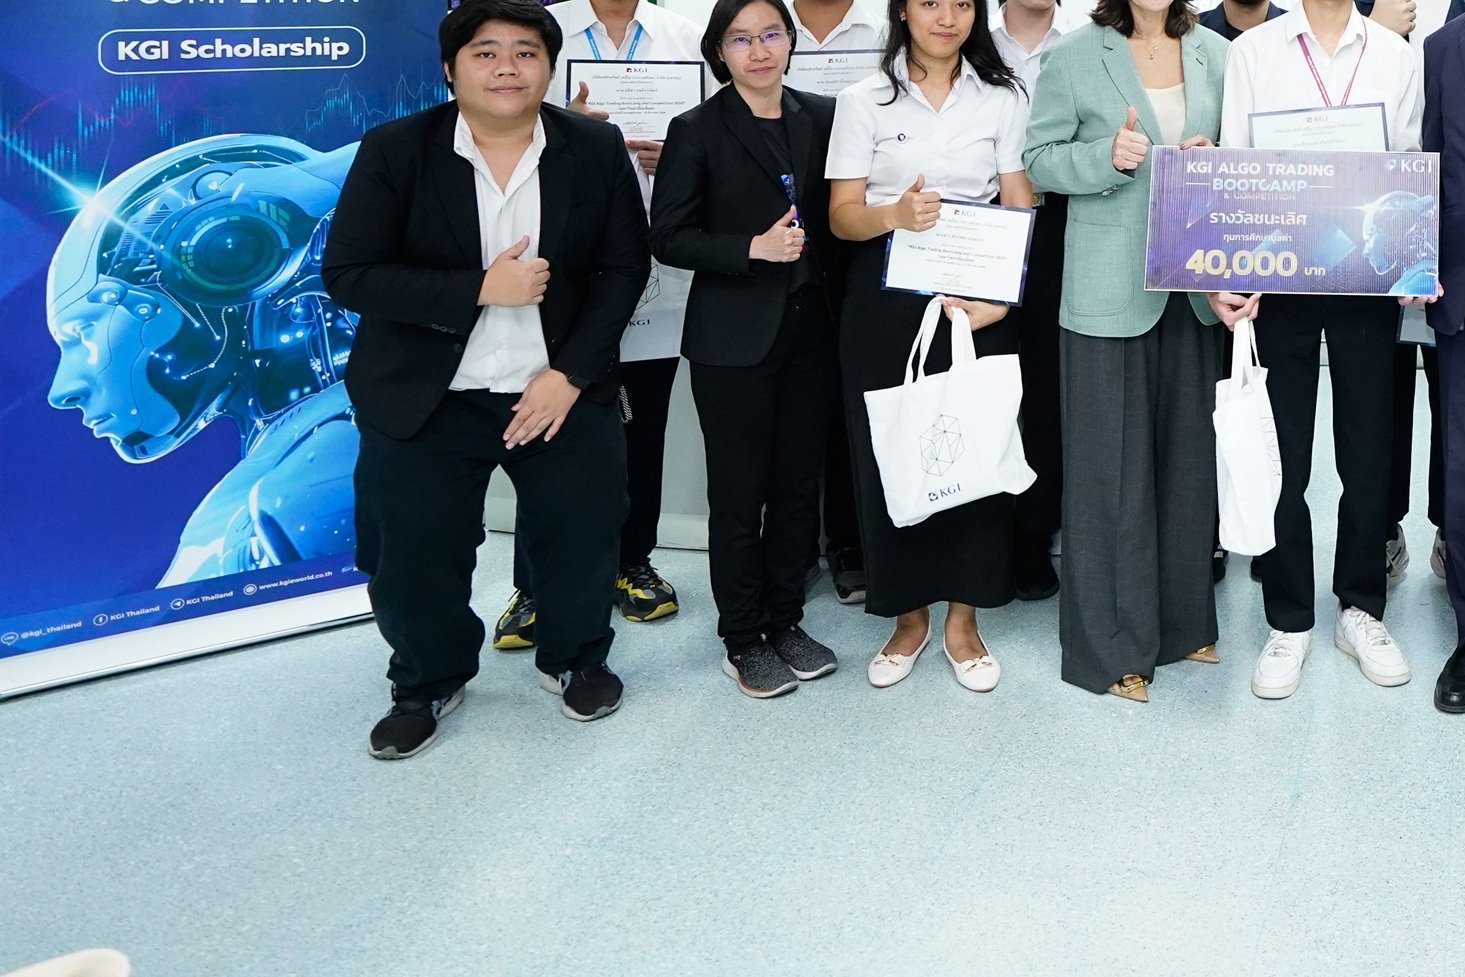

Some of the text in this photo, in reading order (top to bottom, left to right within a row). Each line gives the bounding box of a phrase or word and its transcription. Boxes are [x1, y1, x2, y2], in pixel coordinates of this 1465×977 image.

[118, 36, 350, 61] KGI Scholarship
[1186, 161, 1335, 176] KGI ALGO TRADING
[1401, 160, 1432, 173] KGI
[1212, 178, 1308, 192] BOOTCAMP
[1209, 210, 1307, 225] รางวัลชนะเลิศ
[1186, 249, 1326, 279] 40,000 บาท
[940, 483, 961, 498] KGI
[186, 590, 234, 606] KGI Thailand
[110, 605, 160, 621] KGI Thailand
[20, 620, 82, 639] @kgi_thailand
